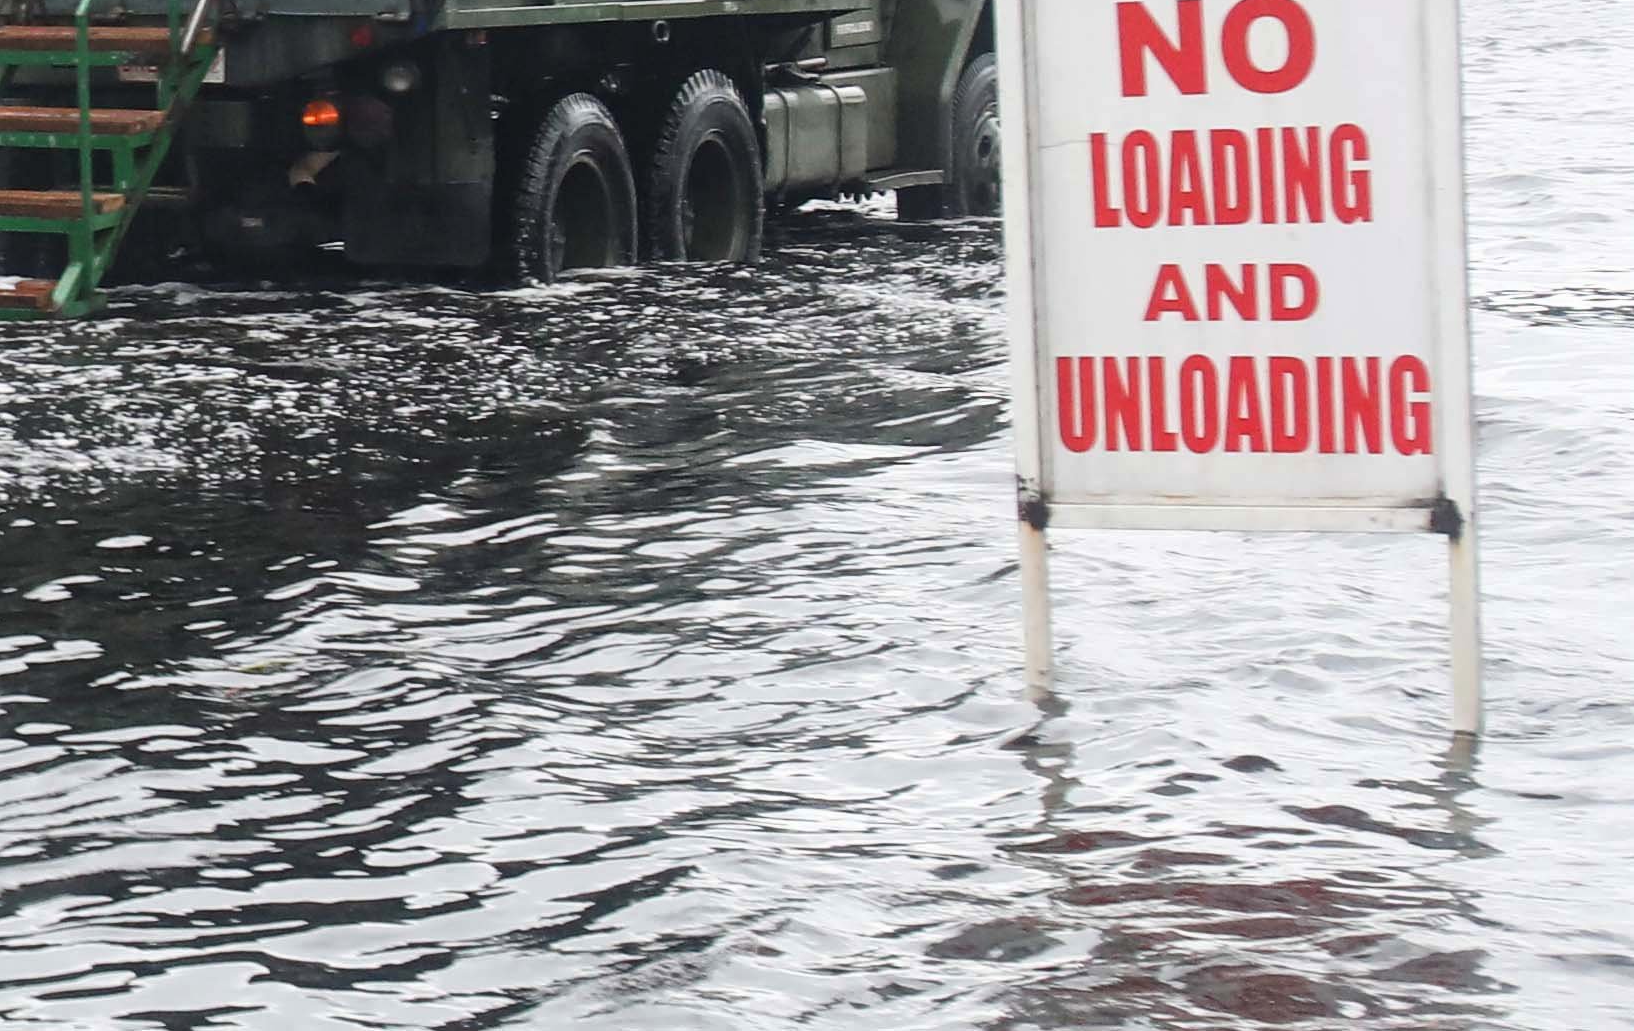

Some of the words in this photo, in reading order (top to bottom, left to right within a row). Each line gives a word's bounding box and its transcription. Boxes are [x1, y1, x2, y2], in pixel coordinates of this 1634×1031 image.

[1090, 123, 1373, 229] LOADING
[1142, 263, 1321, 323] AND
[1055, 354, 1433, 456] UNLOADING
